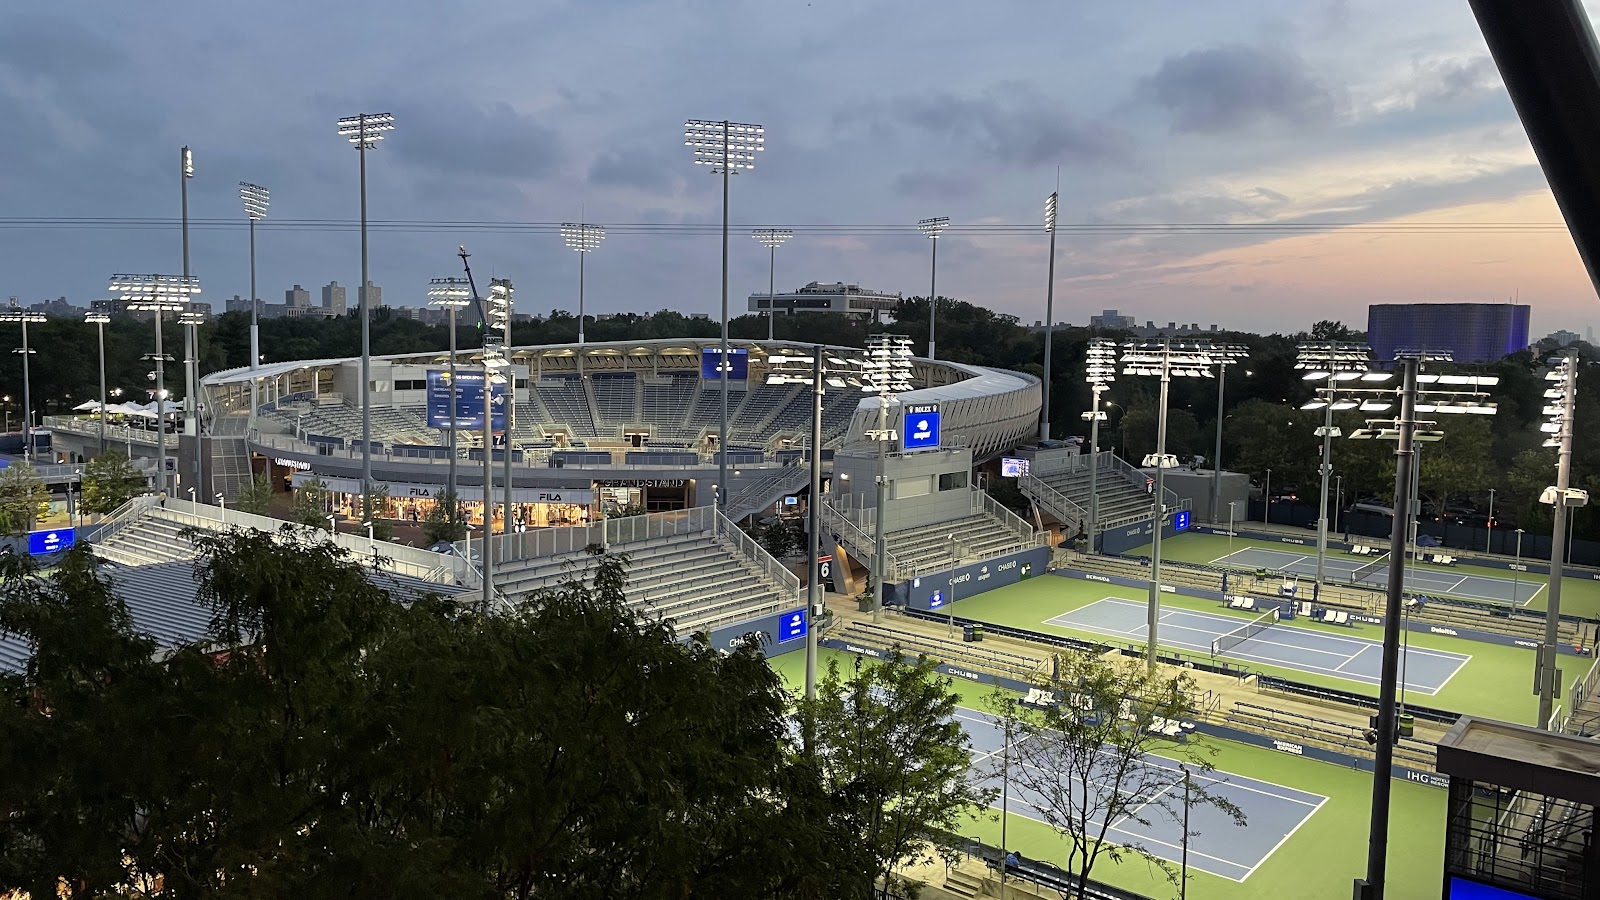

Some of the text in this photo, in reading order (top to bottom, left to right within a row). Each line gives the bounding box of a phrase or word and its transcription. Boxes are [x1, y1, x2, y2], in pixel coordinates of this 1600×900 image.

[495, 435, 501, 444] 7
[603, 479, 685, 488] GRANDSTAND
[409, 488, 429, 496] FILA
[539, 493, 562, 501] FILA
[821, 562, 829, 577] 6
[998, 562, 1013, 572] CHASE
[949, 574, 965, 585] CHASE
[1085, 574, 1110, 582] BERMUDA
[1350, 615, 1380, 624] CHUBB
[948, 668, 978, 679] CHUBB
[1273, 740, 1302, 751] AMERICAN
[1277, 745, 1302, 754] EXPRESS
[1407, 771, 1429, 783] IHG
